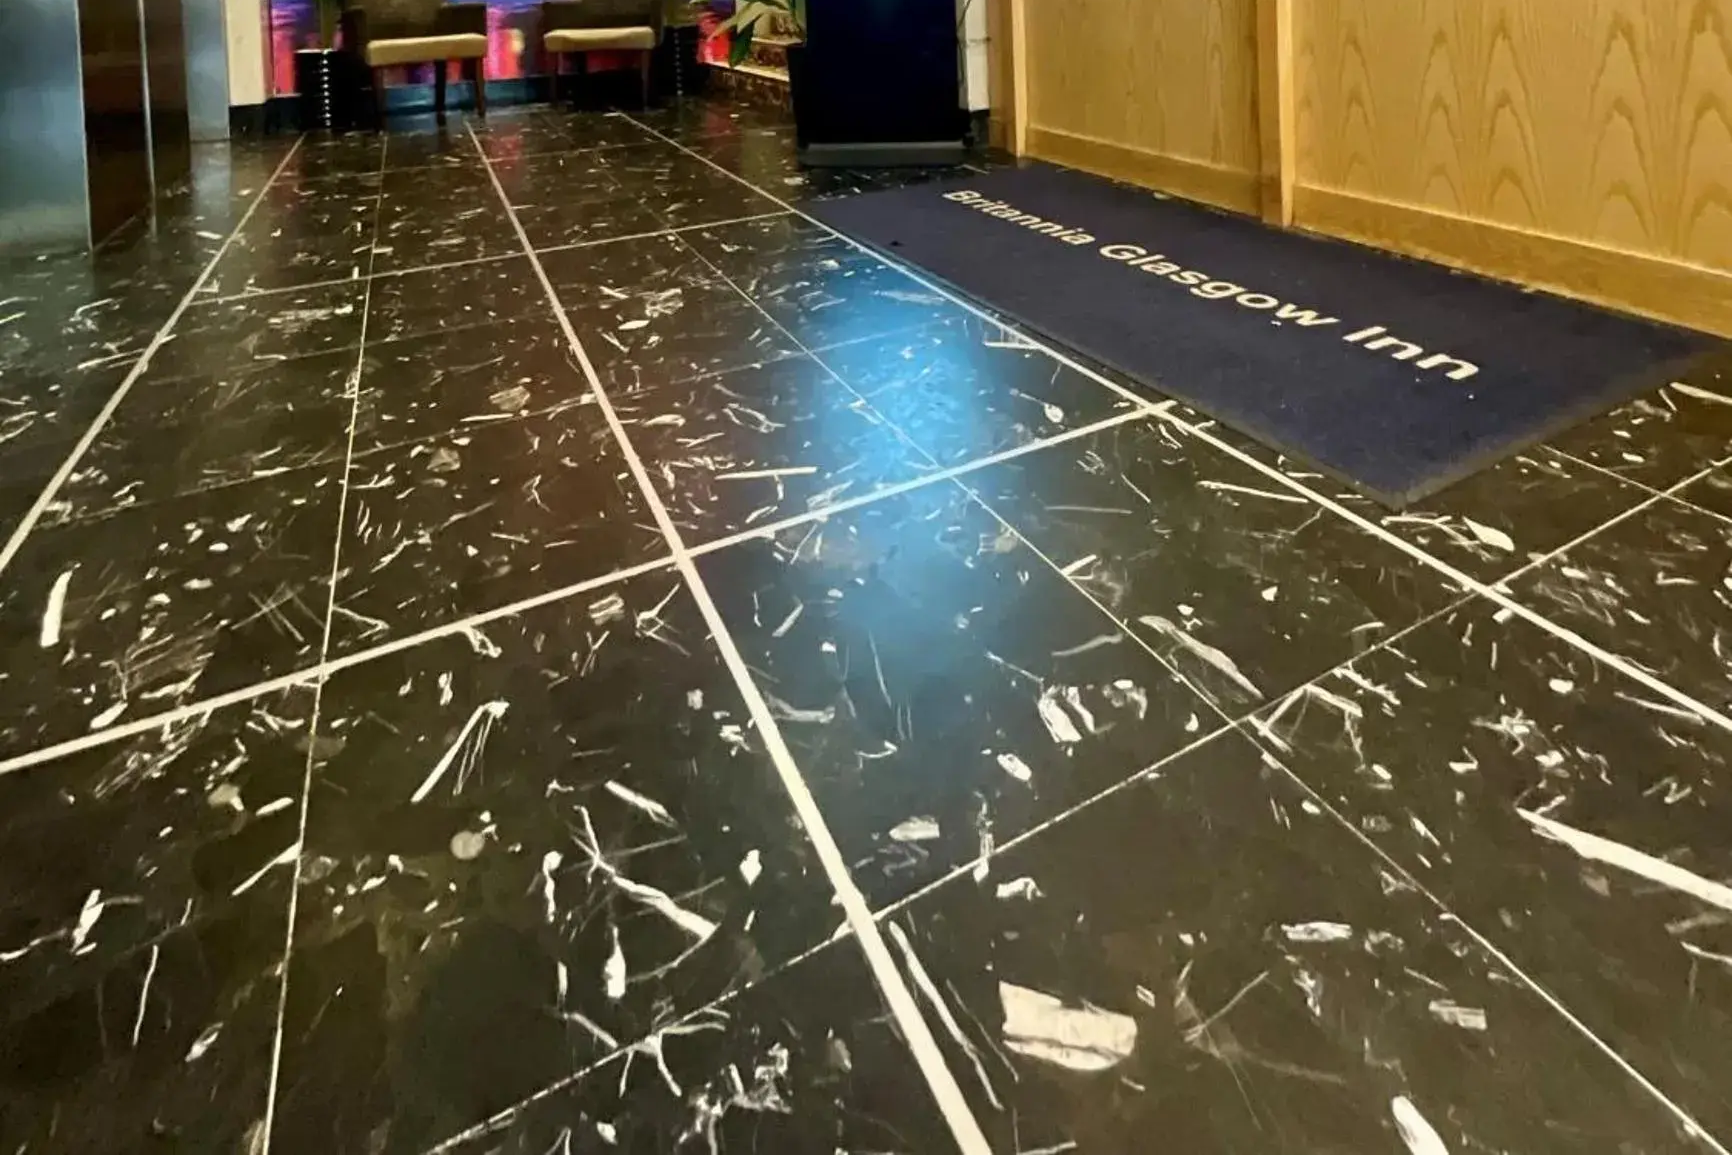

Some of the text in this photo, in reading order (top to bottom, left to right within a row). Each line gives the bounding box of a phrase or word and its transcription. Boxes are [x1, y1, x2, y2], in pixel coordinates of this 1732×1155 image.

[941, 189, 1481, 380] Britannia Glasgow Inn
